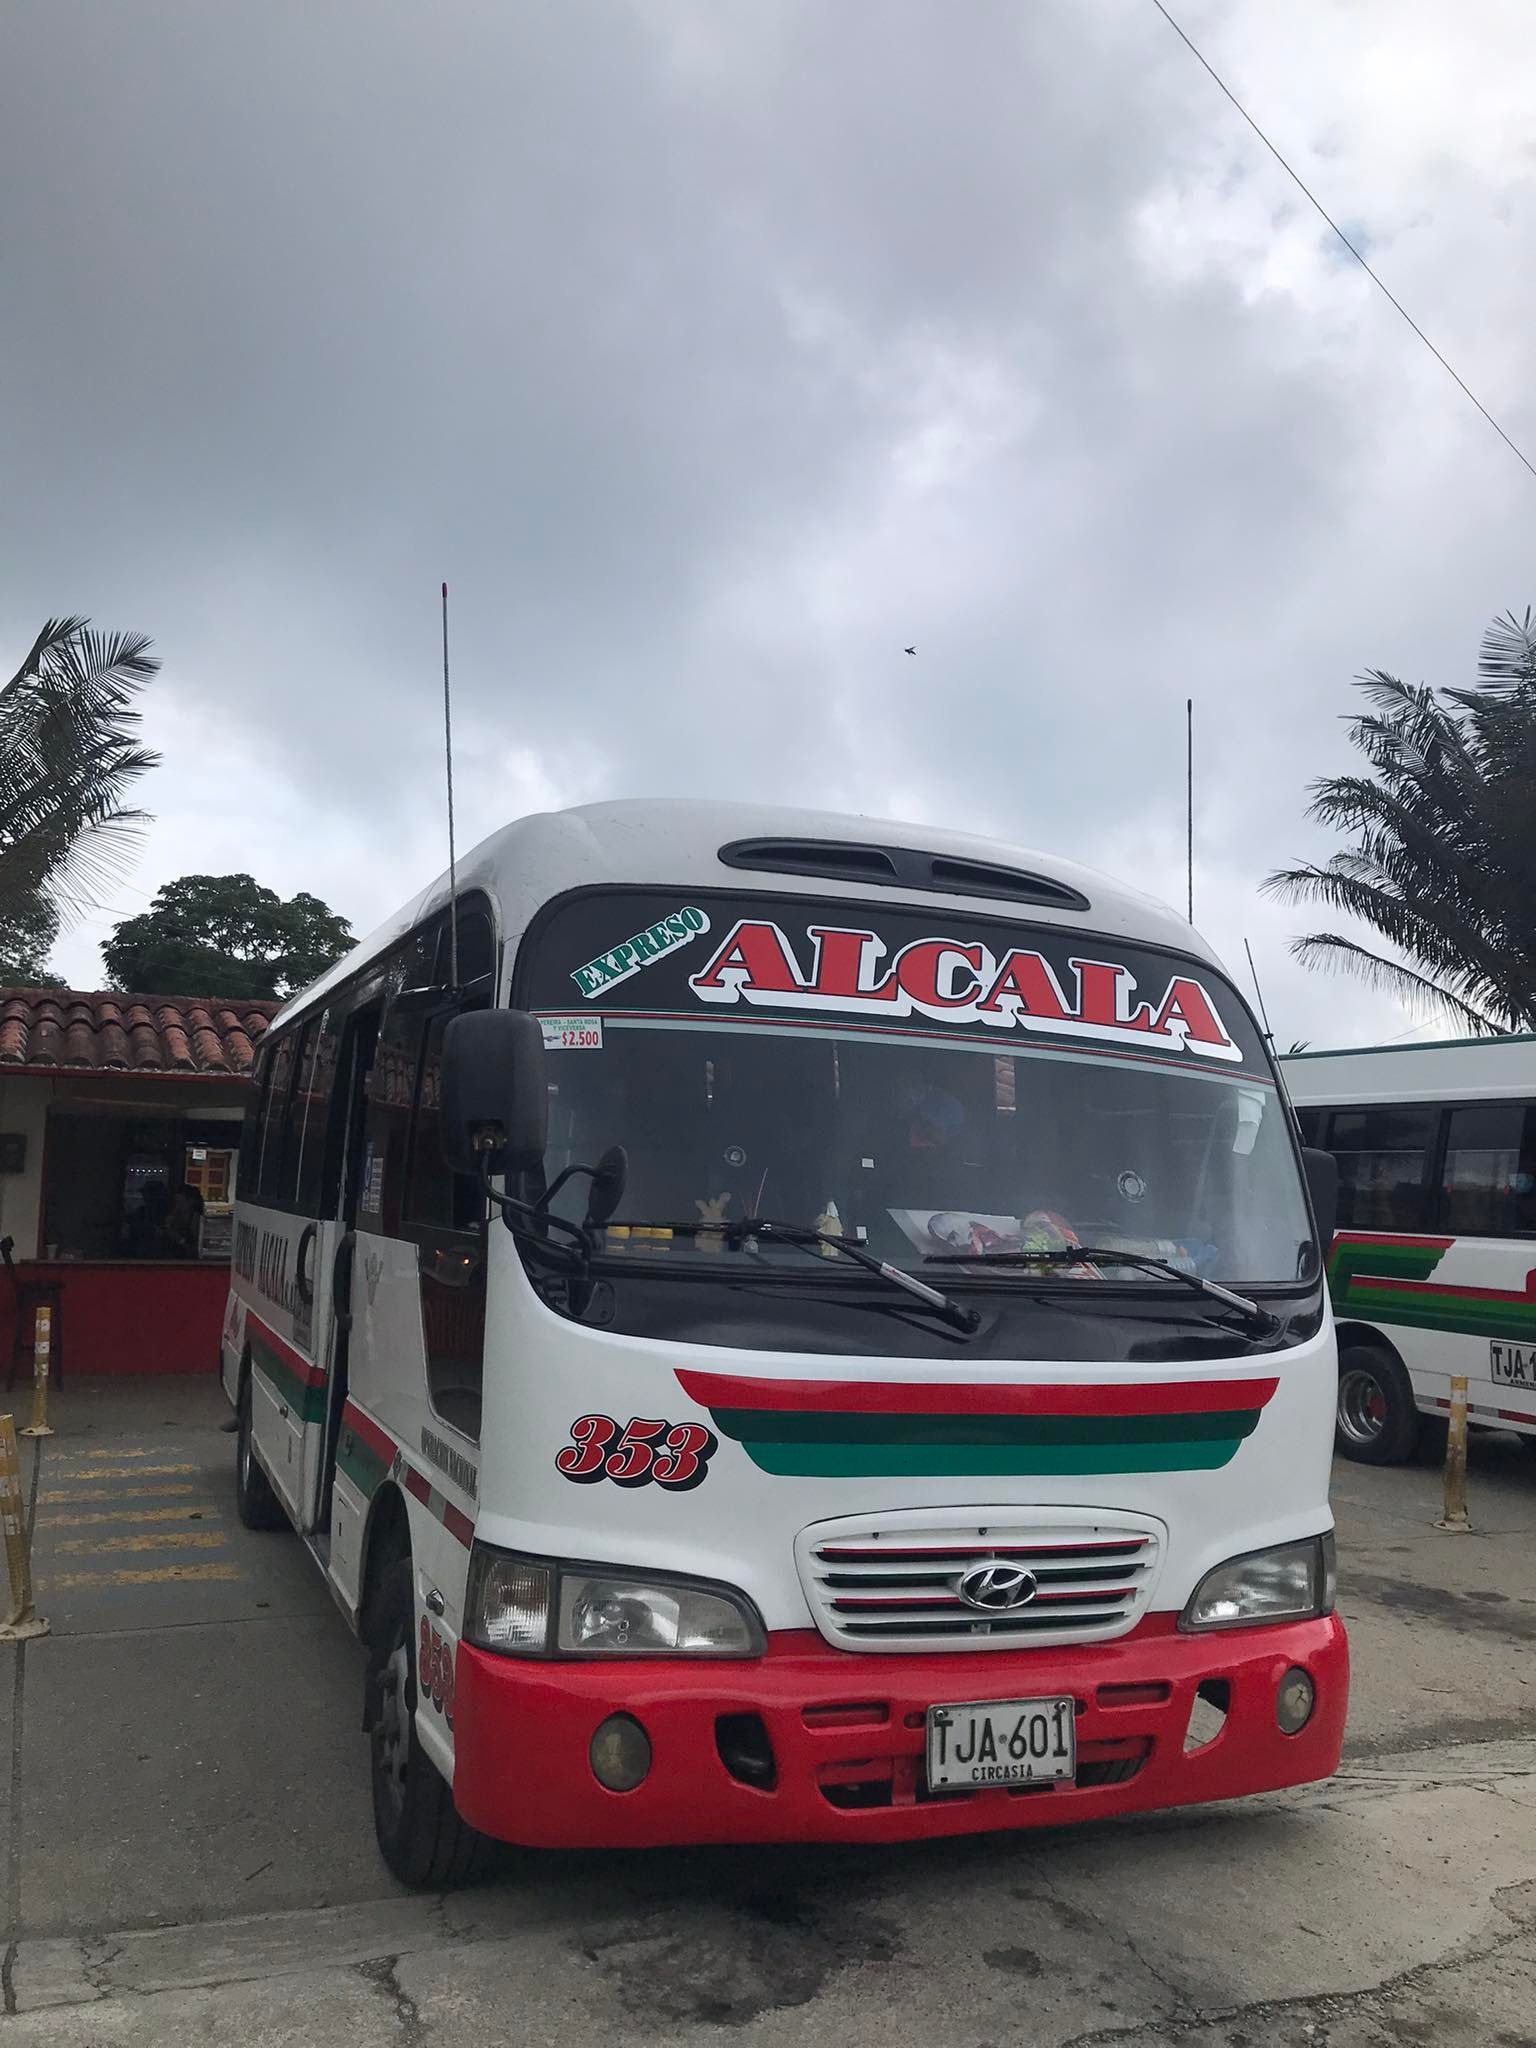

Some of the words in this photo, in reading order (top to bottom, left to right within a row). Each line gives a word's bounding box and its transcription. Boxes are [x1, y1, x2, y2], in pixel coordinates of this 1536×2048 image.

[570, 906, 711, 999] EXPRESO
[688, 918, 1243, 1062] ALCALA
[561, 1030, 599, 1046] $2.500
[555, 1413, 718, 1492] 353
[971, 1764, 1034, 1781] CIRCASIA
